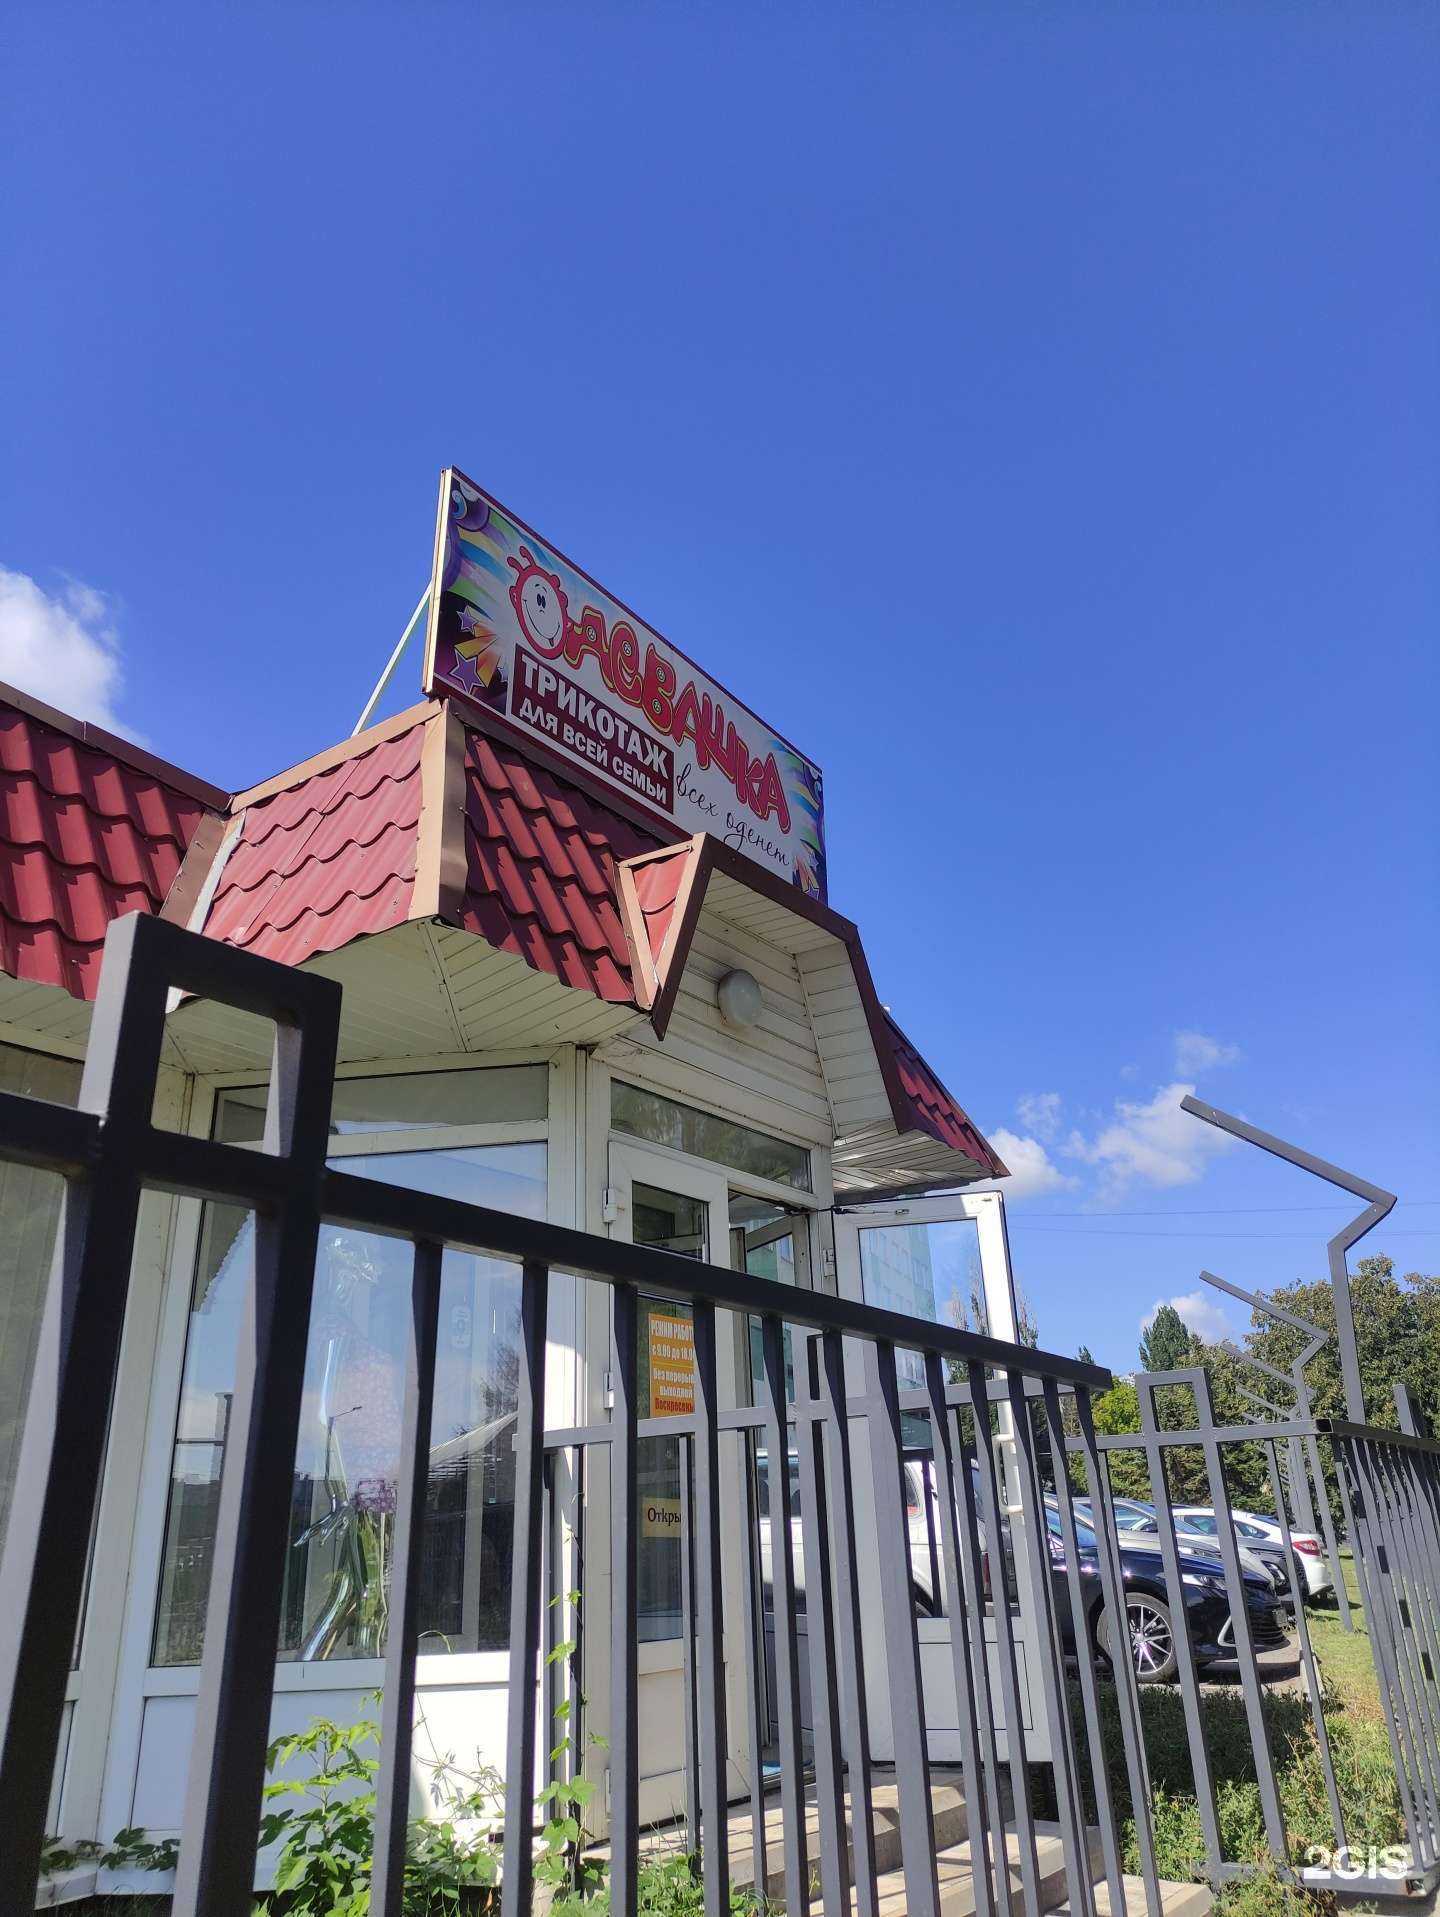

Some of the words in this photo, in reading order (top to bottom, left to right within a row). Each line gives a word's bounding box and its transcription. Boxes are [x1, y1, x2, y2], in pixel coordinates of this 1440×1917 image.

[521, 653, 669, 780] ТРИКОТАЖ
[519, 696, 559, 736] ДЛЯ
[563, 722, 608, 768] ВСЕЙ
[612, 755, 667, 805] СЕМЬИ
[723, 811, 790, 866] оденет
[651, 1319, 673, 1339] РЕЖИМ
[681, 1346, 694, 1361] 18.0
[655, 1397, 695, 1413] Воскресень
[647, 1507, 682, 1527] Откры
